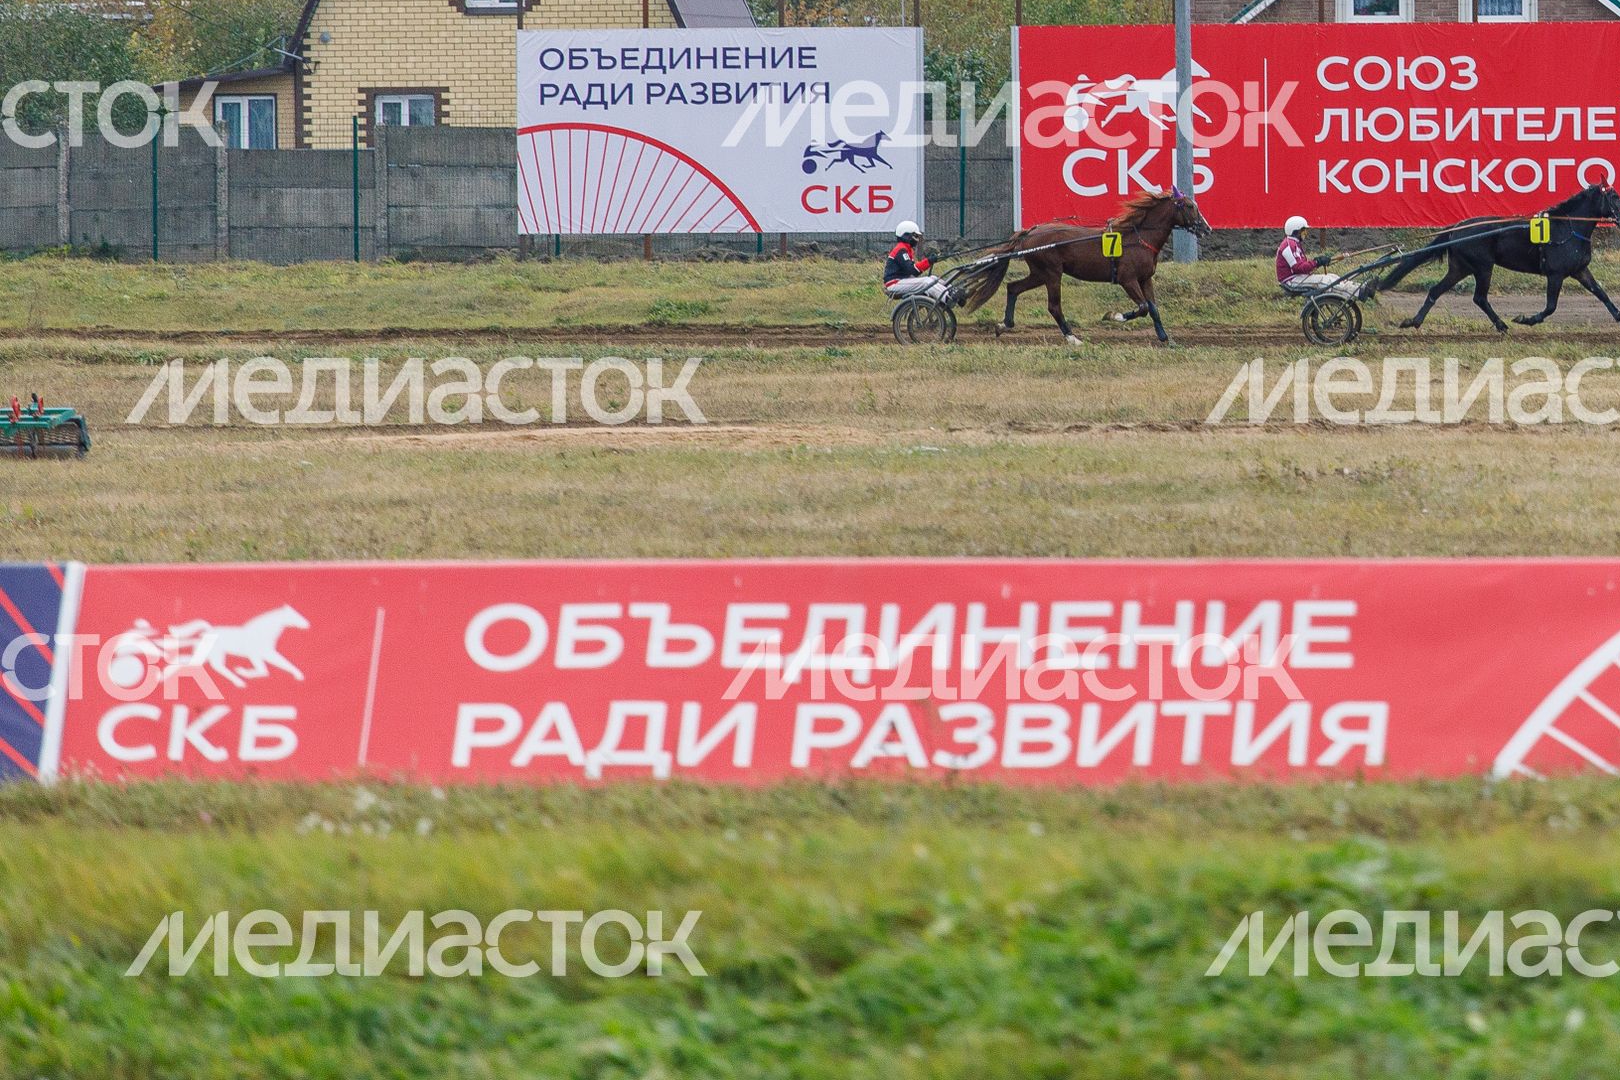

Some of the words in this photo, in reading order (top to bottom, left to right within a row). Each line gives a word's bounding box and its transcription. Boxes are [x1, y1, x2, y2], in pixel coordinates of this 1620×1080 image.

[539, 46, 818, 74] ОБЪЕДИНЕНИЕ
[1316, 55, 1479, 91] СОЮЗ
[539, 82, 634, 110] РАДИ
[645, 81, 831, 106] РАЗВИТИЯ
[1062, 148, 1215, 197] СКБ
[1318, 157, 1616, 193] КОНСКОГО
[801, 184, 895, 214] СКБ
[1106, 235, 1117, 255] 7
[464, 601, 1357, 684] ОБЪЕДИНЕНИЕ
[96, 706, 299, 763] СКБ
[450, 702, 760, 779] РАДИ
[789, 701, 1389, 769] РАЗВИТИЯ
